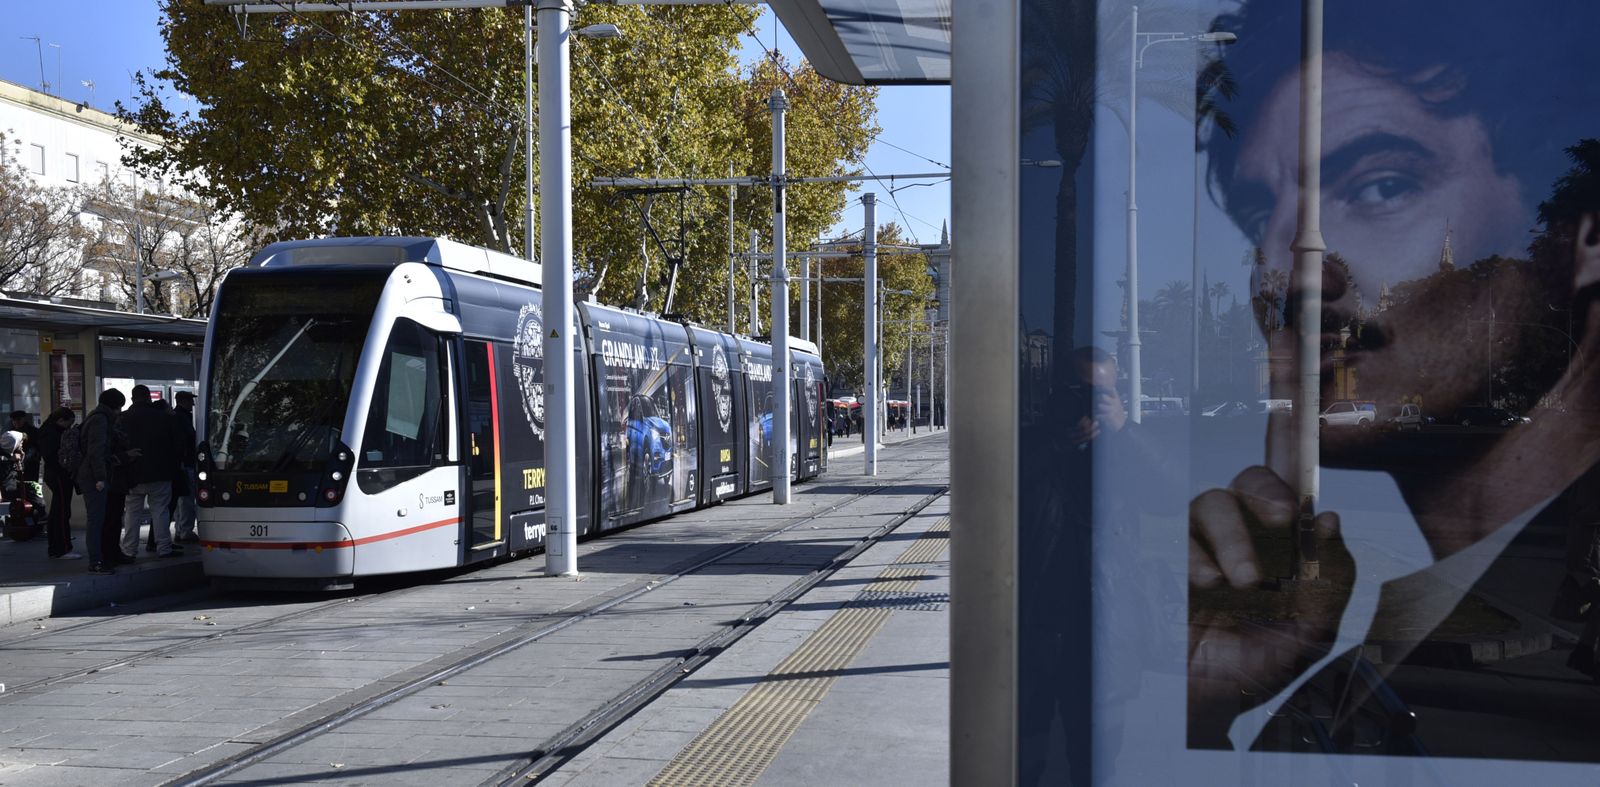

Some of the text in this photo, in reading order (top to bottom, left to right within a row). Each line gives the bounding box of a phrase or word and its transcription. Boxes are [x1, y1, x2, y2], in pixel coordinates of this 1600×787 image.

[602, 339, 649, 370] GRANDLAND
[425, 495, 443, 505] TUSSAM
[250, 525, 268, 537] 301
